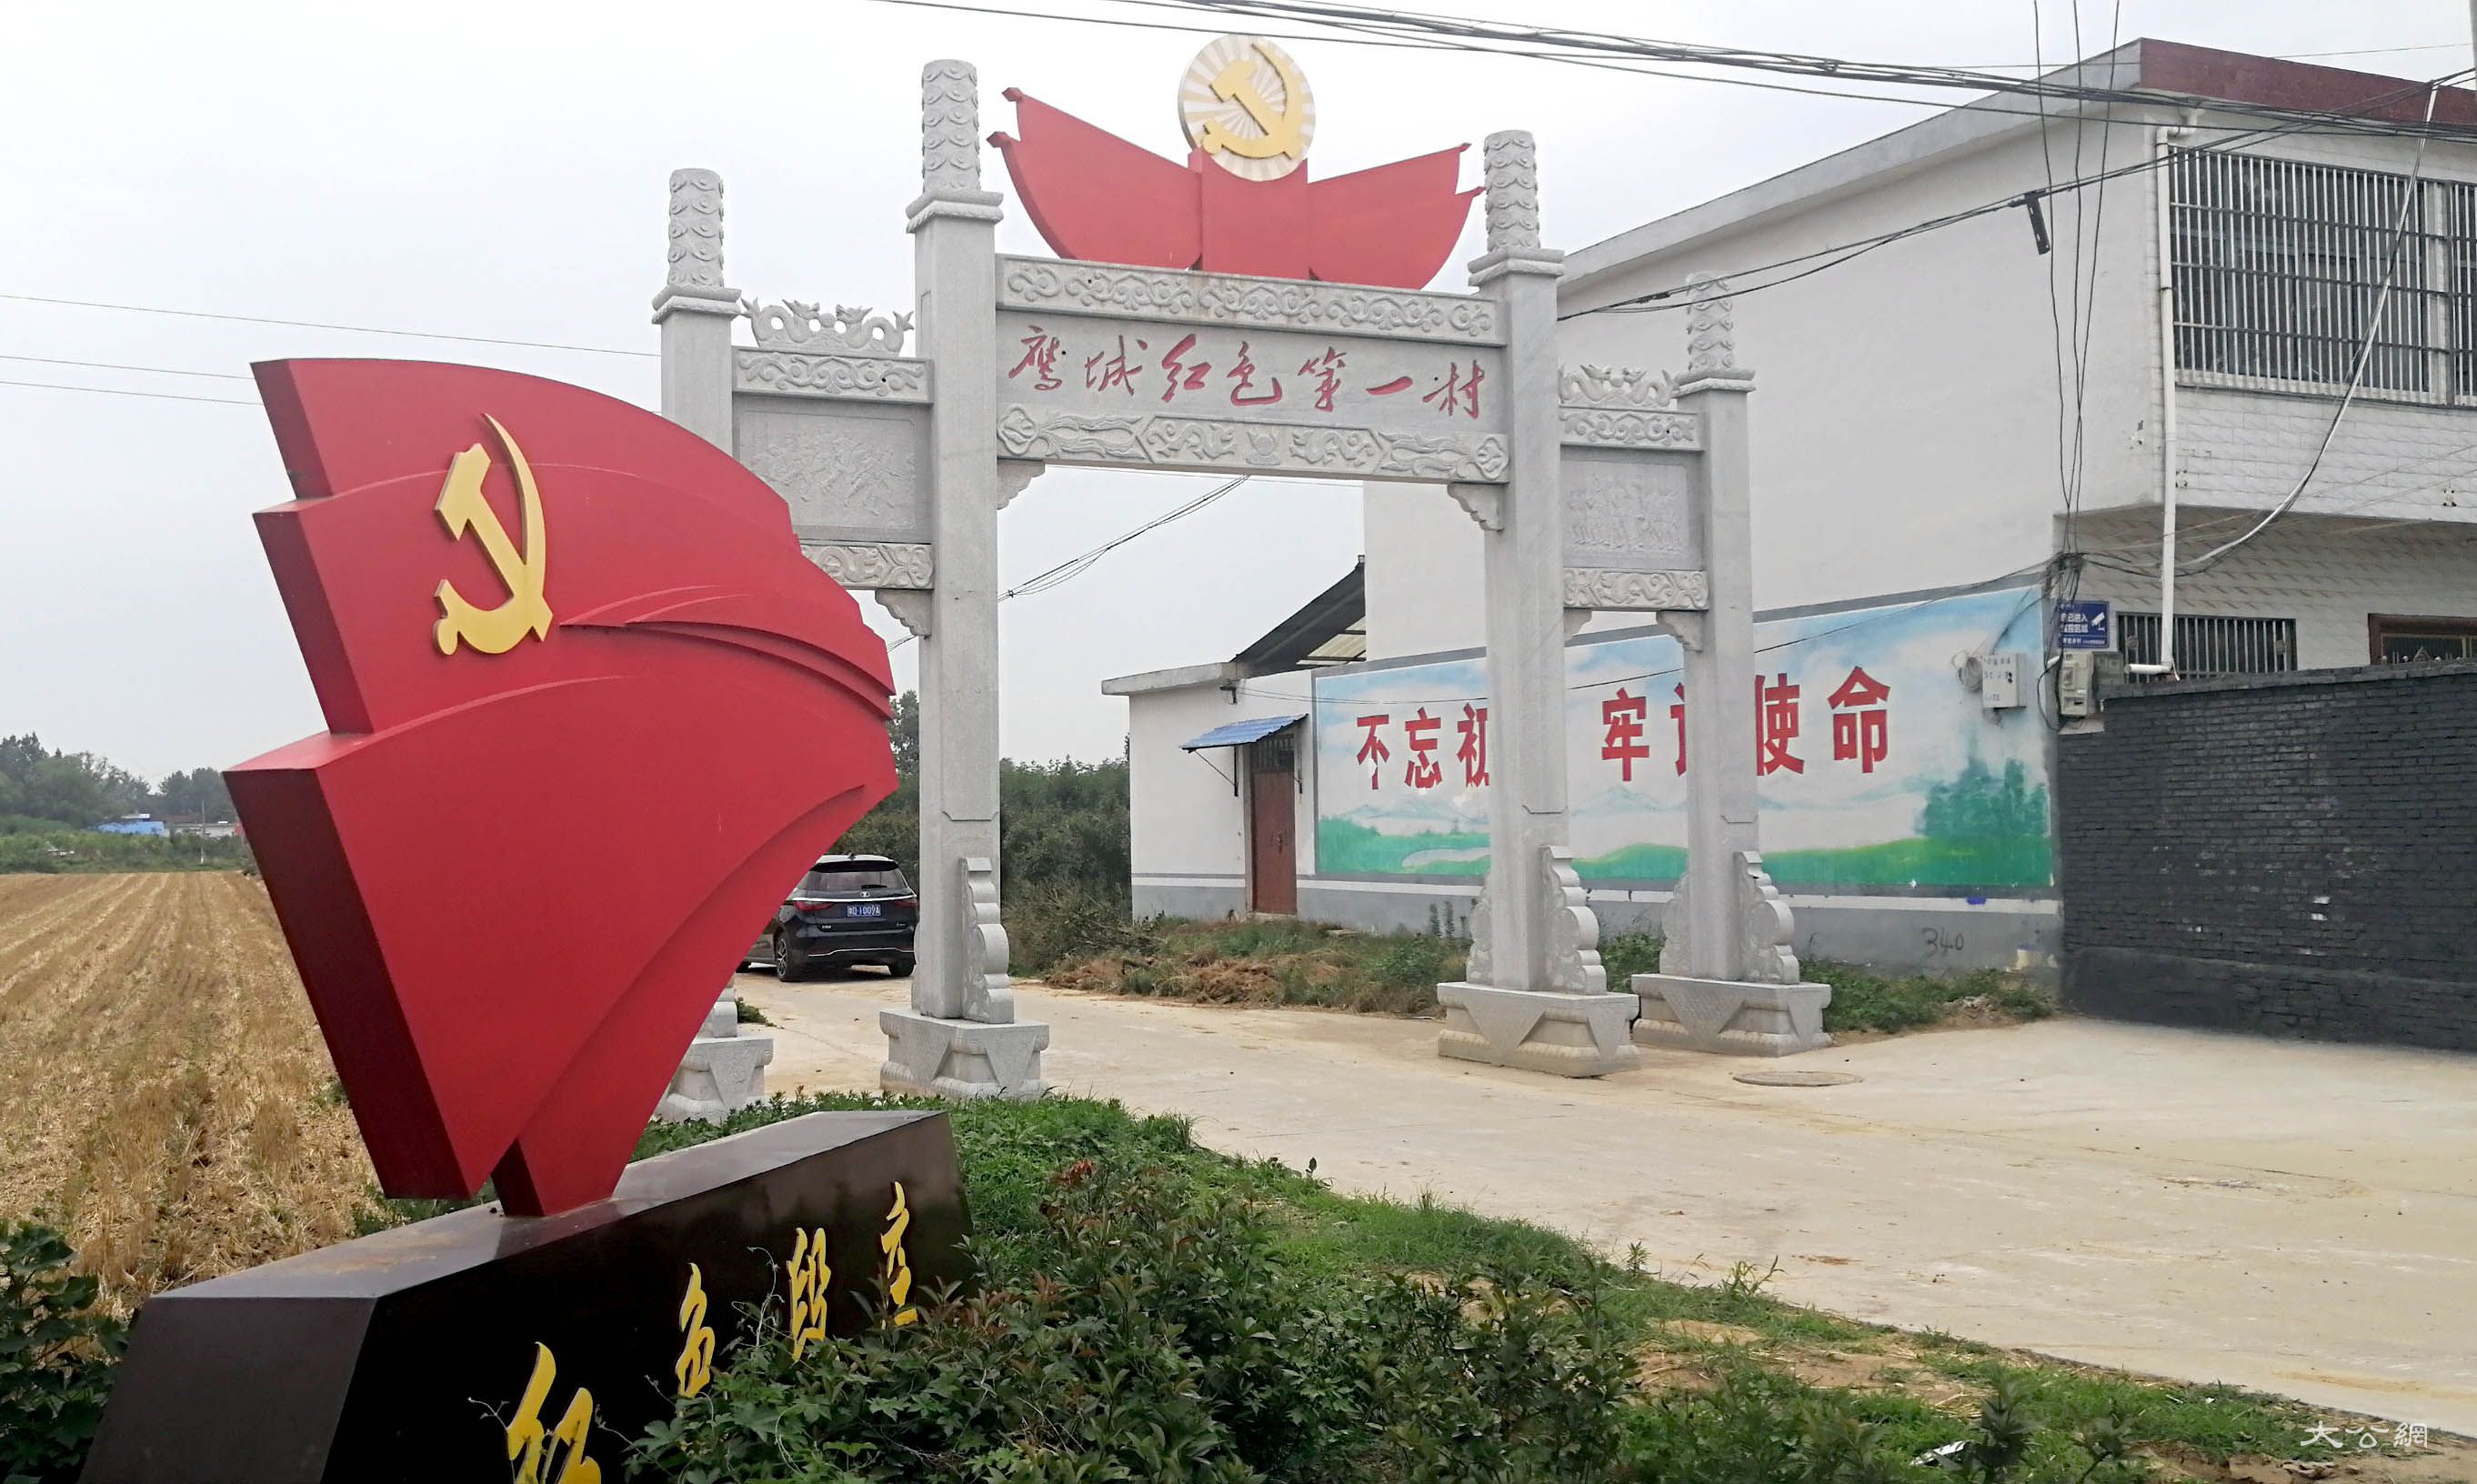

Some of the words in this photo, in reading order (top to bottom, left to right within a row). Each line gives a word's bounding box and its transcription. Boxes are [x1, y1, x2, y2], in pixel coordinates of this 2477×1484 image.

[1008, 325, 1486, 419] 鹰城红色第一村
[1357, 703, 1489, 790] 不忘初
[1920, 927, 1964, 955] 340
